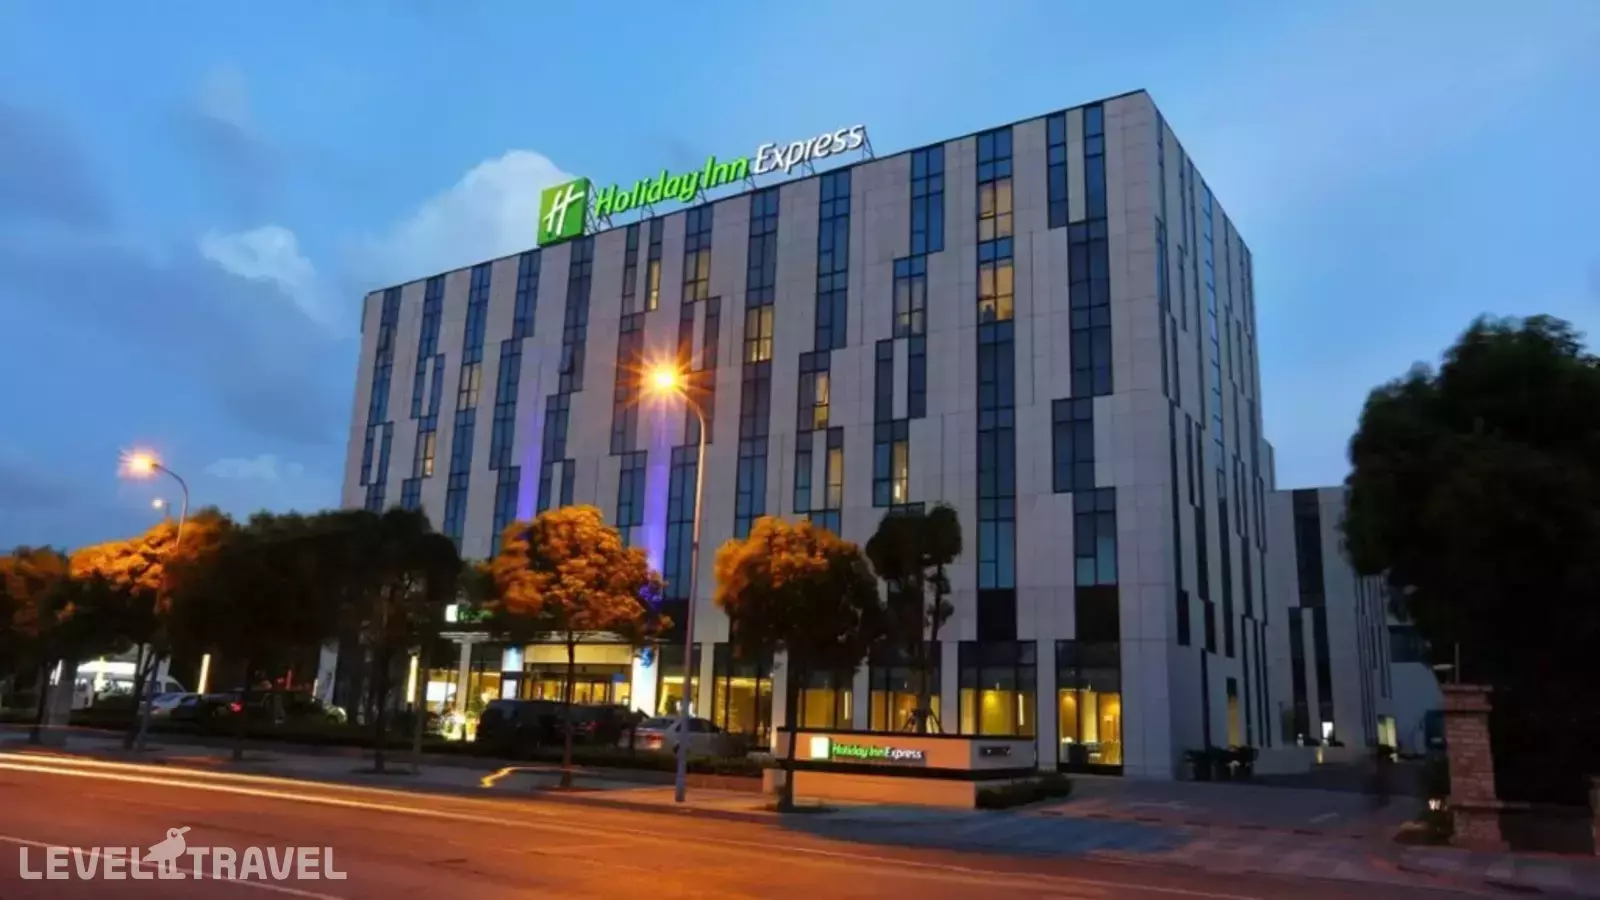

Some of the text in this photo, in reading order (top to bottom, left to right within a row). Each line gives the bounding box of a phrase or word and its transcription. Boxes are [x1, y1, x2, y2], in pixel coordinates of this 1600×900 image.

[595, 124, 864, 218] Holiday Inn Express
[832, 743, 868, 758] Holiday
[884, 747, 922, 760] Express
